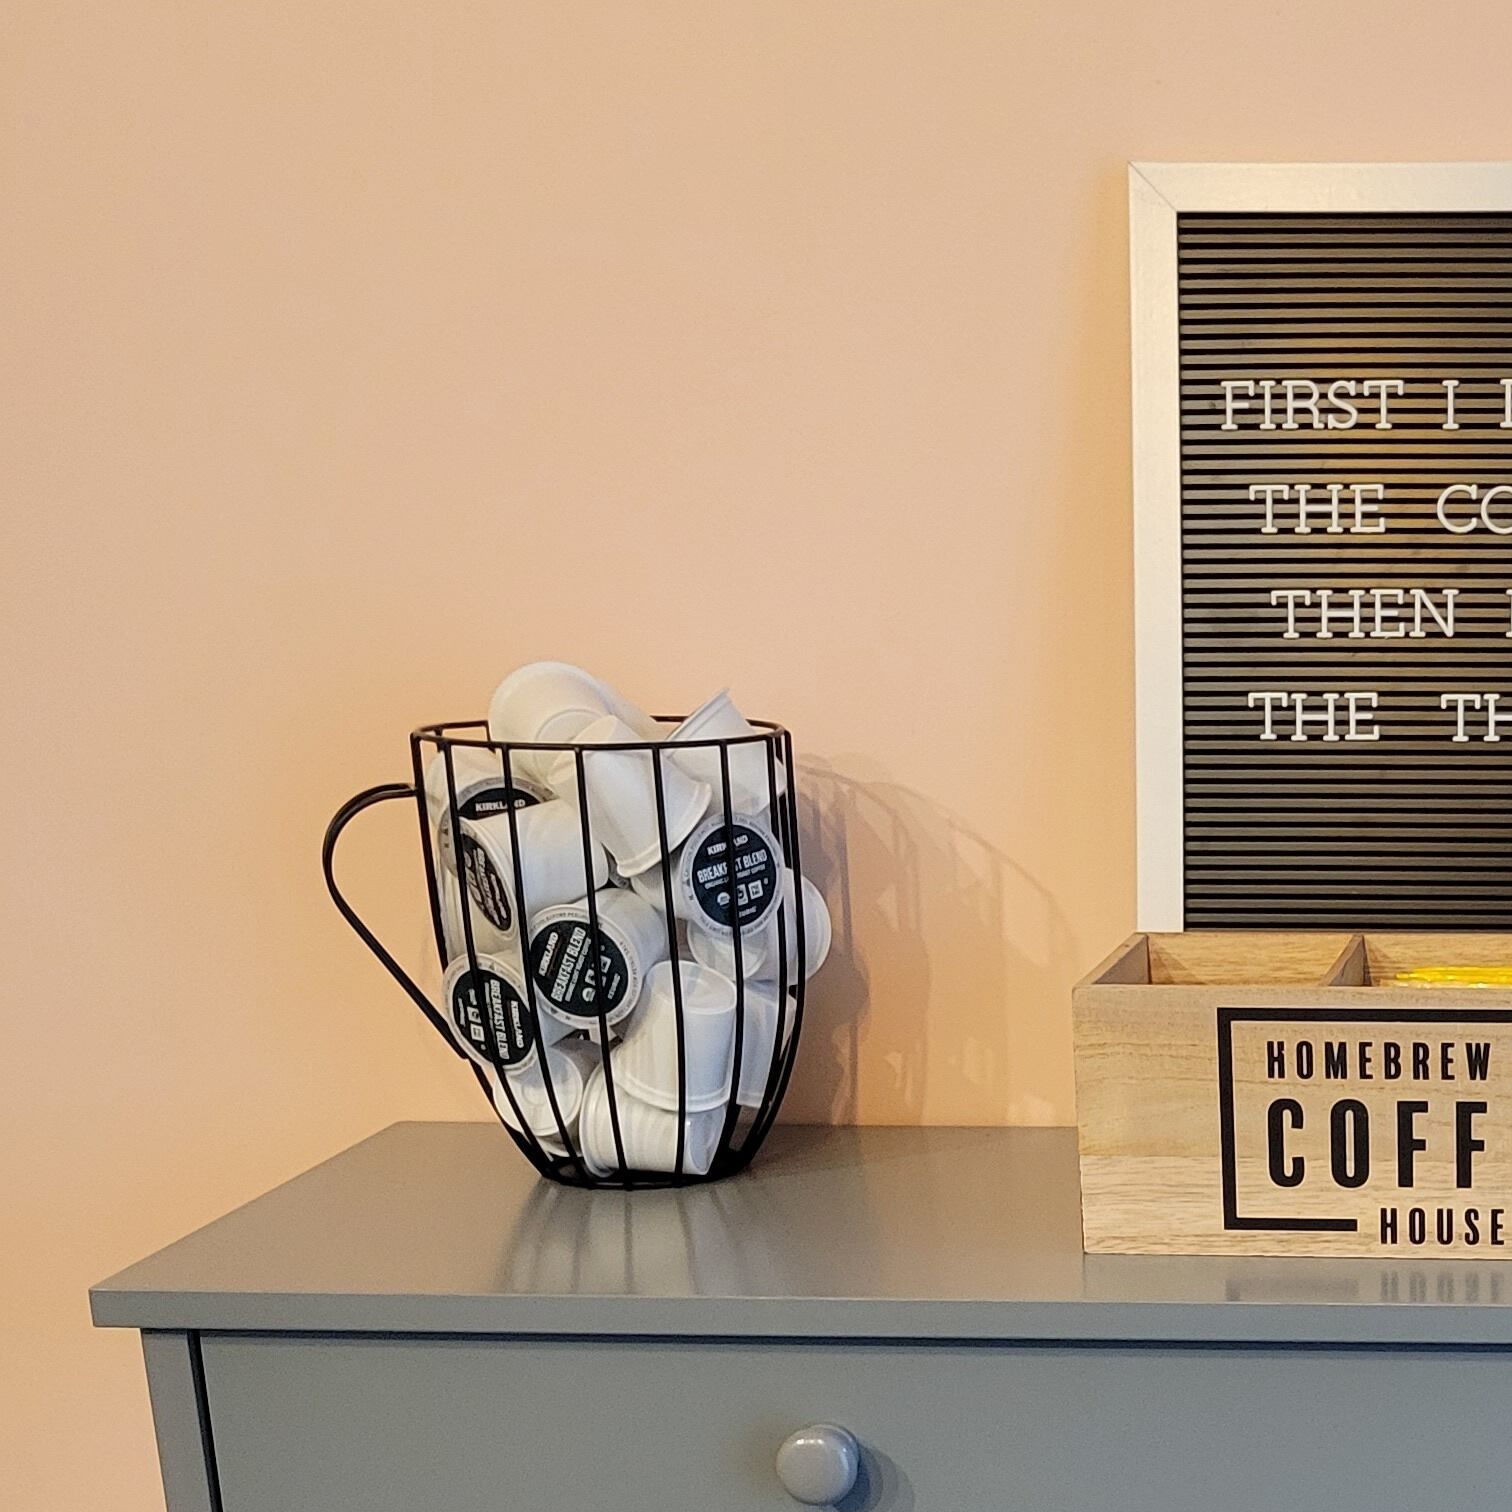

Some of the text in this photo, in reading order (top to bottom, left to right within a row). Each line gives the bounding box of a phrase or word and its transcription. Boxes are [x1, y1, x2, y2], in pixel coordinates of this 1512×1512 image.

[1221, 379, 1404, 431] FIRST
[1442, 379, 1459, 430] I
[1248, 483, 1387, 534] THE
[1270, 589, 1456, 639] THEN
[1247, 691, 1380, 742] THE
[475, 799, 526, 812] KIRKLND
[742, 849, 768, 869] BLEND
[550, 953, 575, 1003] BREAKFAST
[566, 926, 587, 957] BLEND
[490, 979, 506, 1032] BREAKFAST
[1266, 1040, 1491, 1081] HOMEBREW
[1380, 1207, 1506, 1246] HOUSE
